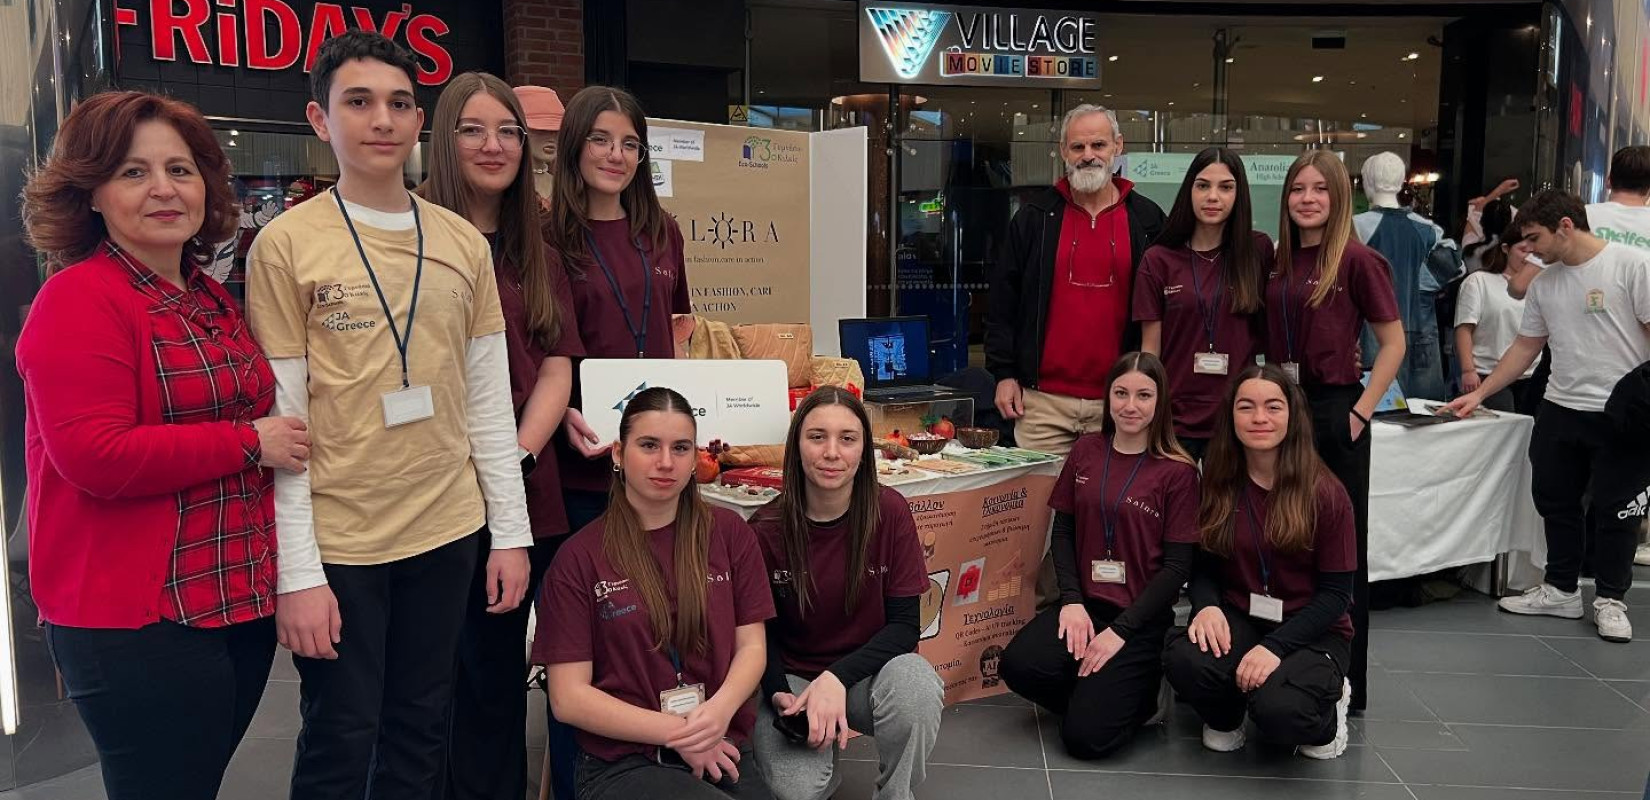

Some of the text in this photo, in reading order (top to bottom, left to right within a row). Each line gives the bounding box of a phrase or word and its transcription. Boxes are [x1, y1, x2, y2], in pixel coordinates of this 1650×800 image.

[954, 12, 1097, 54] VILLAGE
[948, 55, 1095, 76] MOVIE STORE
[702, 302, 737, 312] ACTION
[335, 311, 350, 320] JA
[336, 320, 376, 331] Greece
[1020, 487, 1028, 498] &
[932, 658, 962, 672] οτομία,
